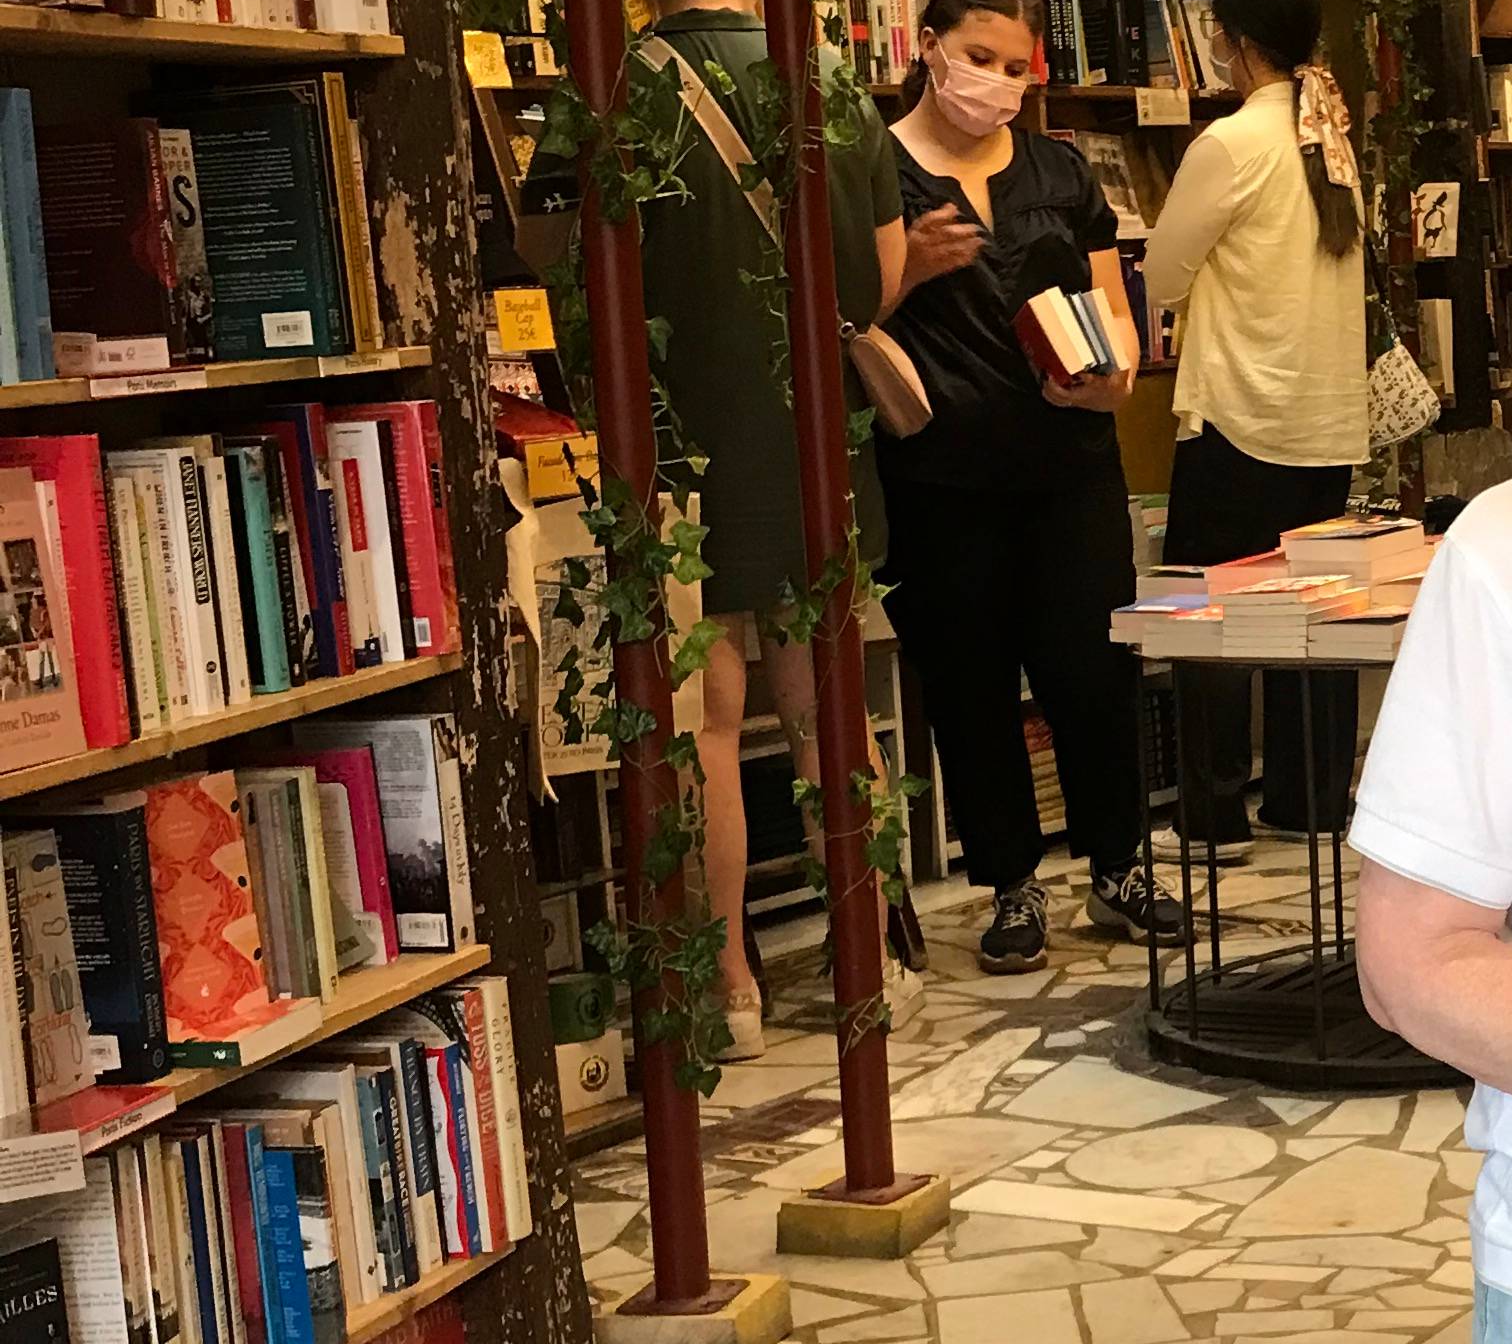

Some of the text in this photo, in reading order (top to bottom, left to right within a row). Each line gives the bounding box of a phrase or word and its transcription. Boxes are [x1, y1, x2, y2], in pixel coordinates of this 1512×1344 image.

[517, 328, 537, 341] 25€
[193, 557, 210, 604] WORLD
[491, 1017, 506, 1076] GLORY
